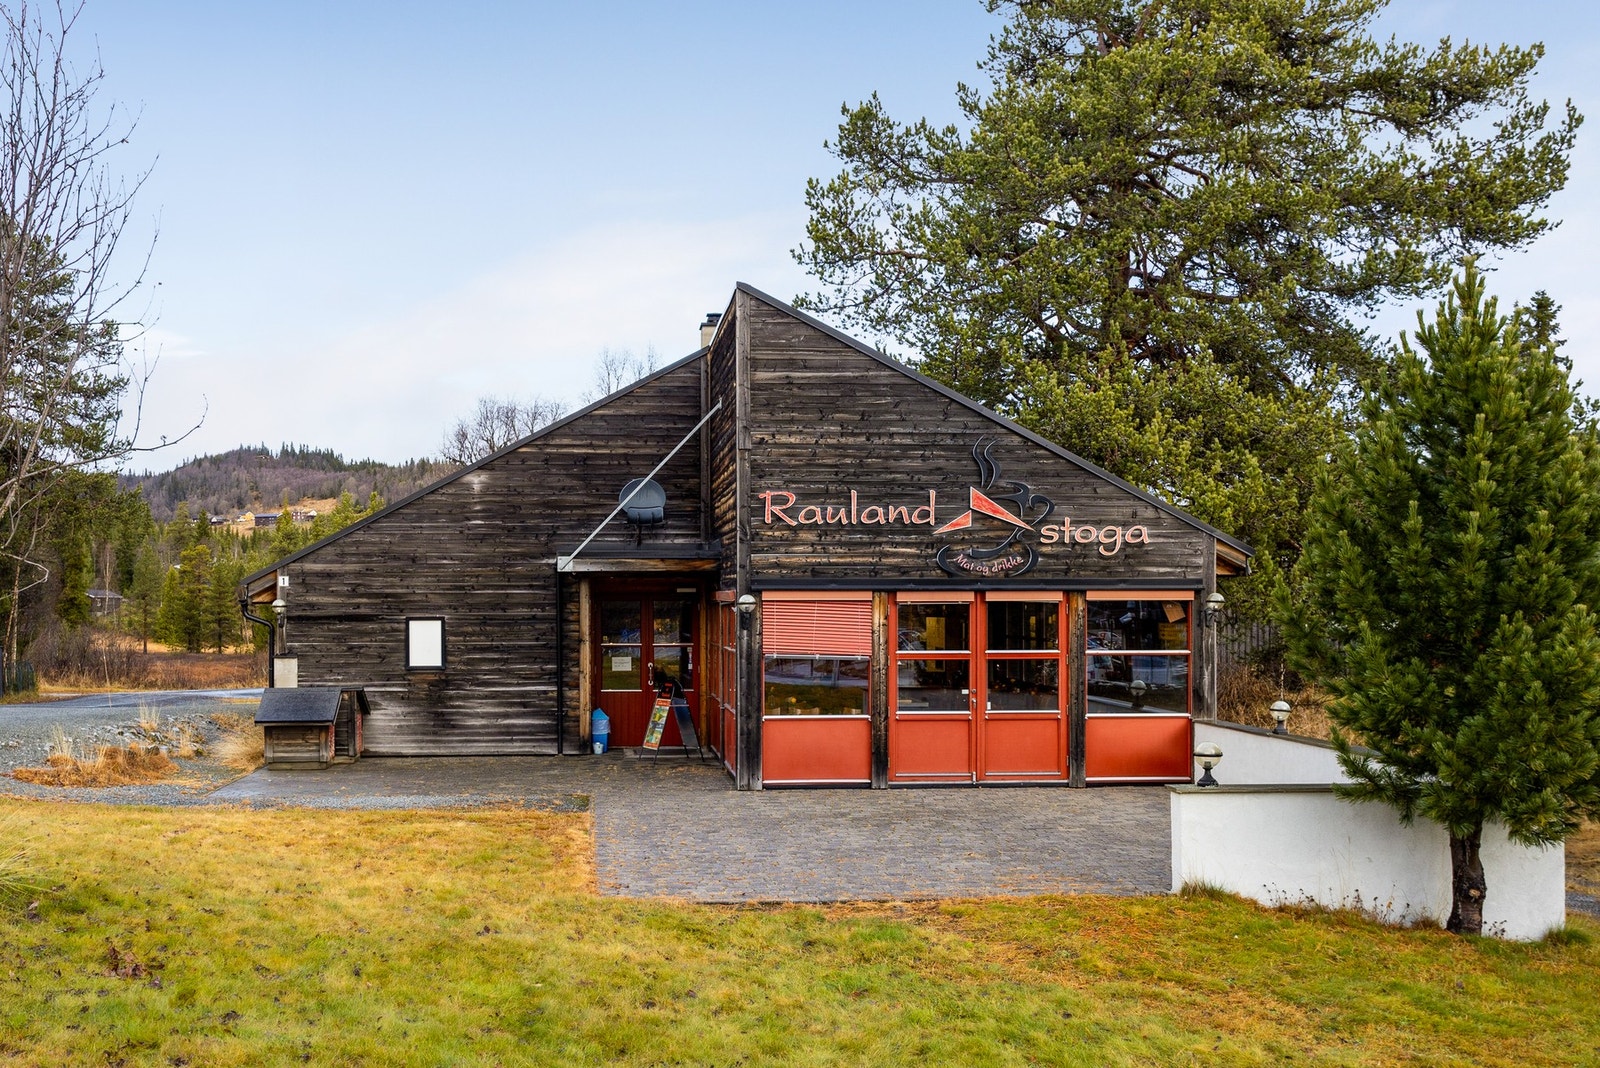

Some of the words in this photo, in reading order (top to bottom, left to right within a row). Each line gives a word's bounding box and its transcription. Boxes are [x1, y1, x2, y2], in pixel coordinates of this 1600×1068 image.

[758, 489, 936, 527] Rauland
[1039, 516, 1150, 556] stoga
[953, 553, 974, 571] Mat
[976, 565, 989, 575] og
[992, 556, 1024, 573] drikke
